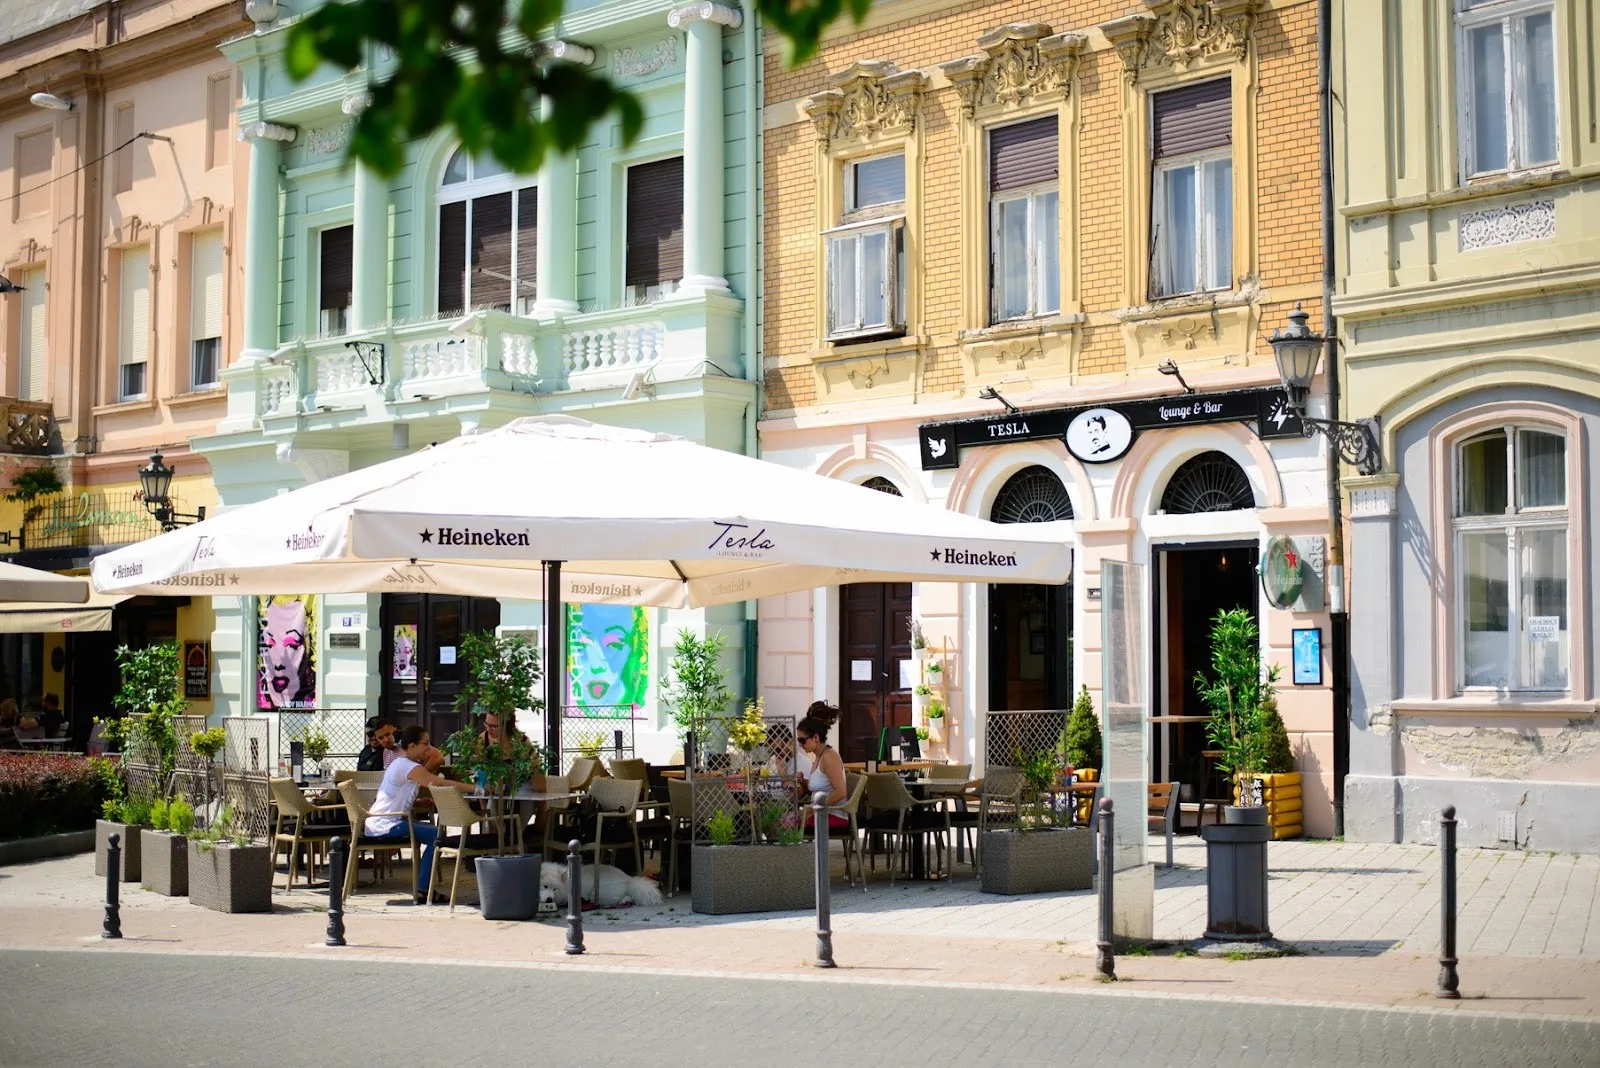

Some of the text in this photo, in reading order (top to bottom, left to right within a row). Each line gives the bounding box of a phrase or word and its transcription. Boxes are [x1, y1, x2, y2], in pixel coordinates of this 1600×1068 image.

[1159, 401, 1223, 421] Lounge & Bar
[987, 421, 1030, 437] TESLA
[437, 527, 531, 546] Heineken
[708, 520, 776, 550] Tesla
[192, 535, 216, 562] Tesla
[944, 548, 1018, 567] Heineken
[116, 561, 143, 579] Heineken
